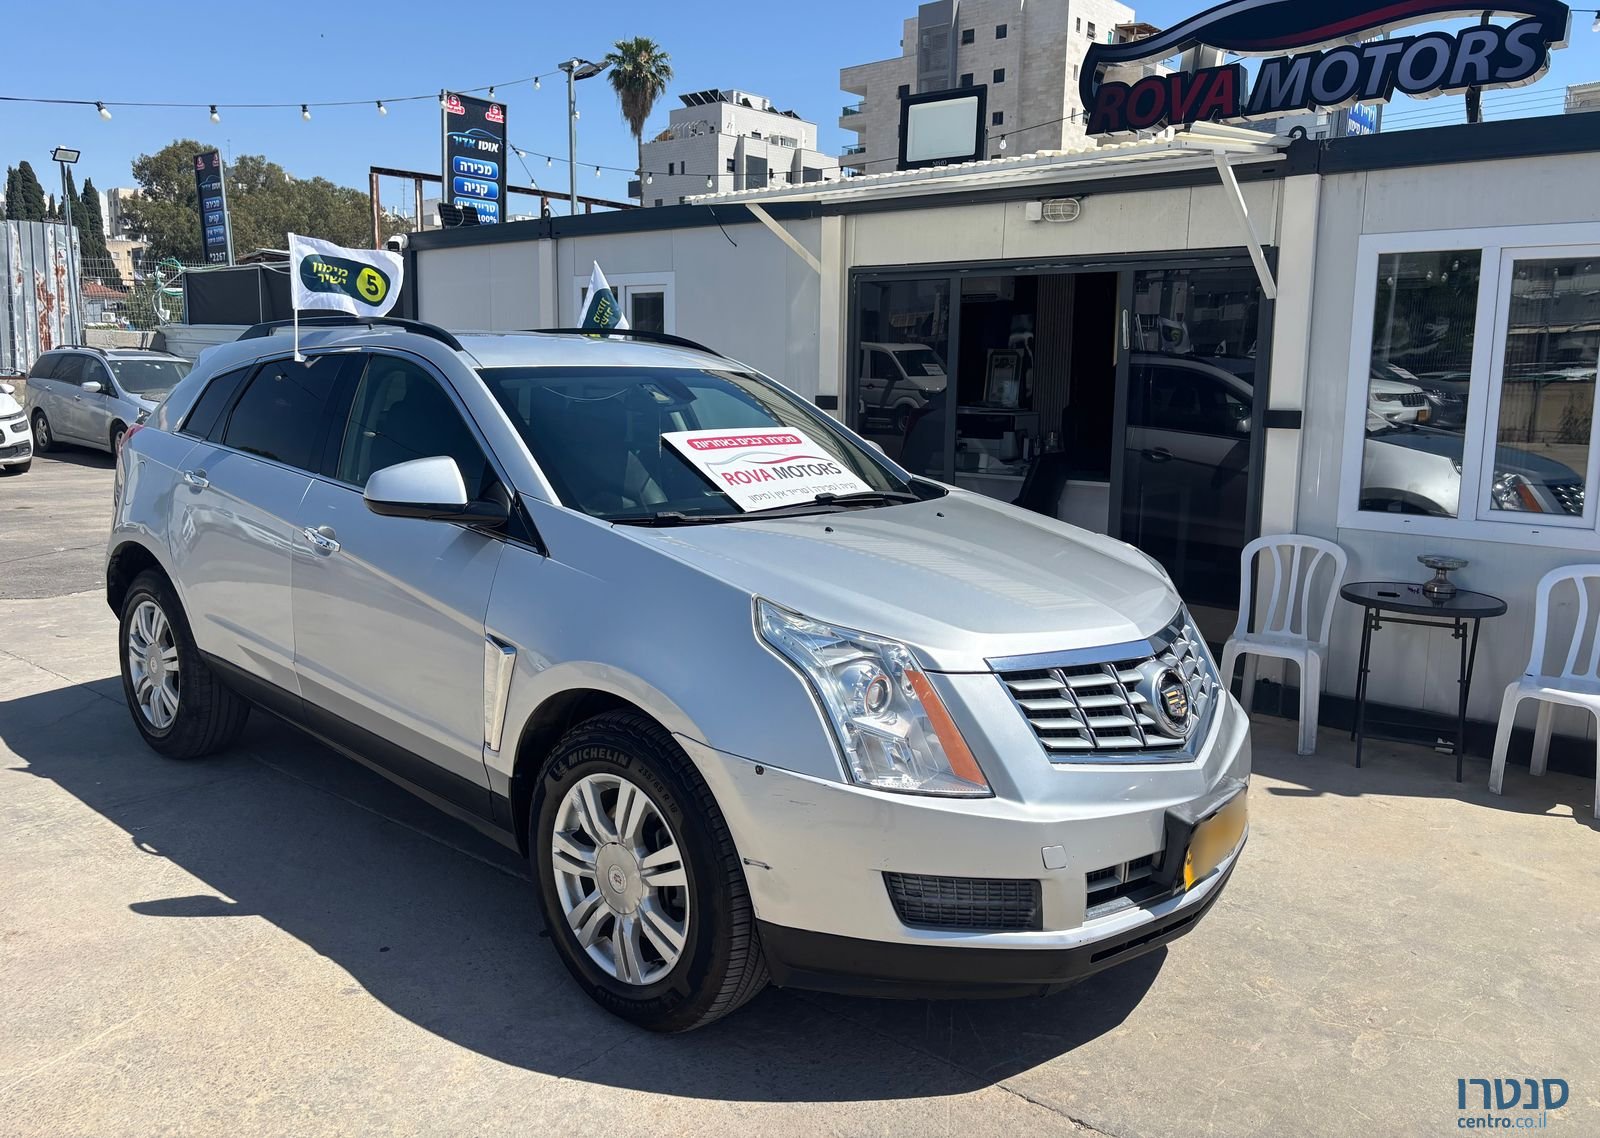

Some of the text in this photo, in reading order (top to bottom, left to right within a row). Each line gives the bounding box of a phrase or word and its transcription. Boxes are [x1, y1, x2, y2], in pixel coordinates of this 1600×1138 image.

[1100, 22, 1544, 128] ROVA MOTORS
[478, 140, 499, 153] אוטו
[460, 161, 492, 175] מכירה
[463, 181, 488, 197] קניה
[312, 261, 349, 277] מימון
[317, 273, 347, 285] ישיר
[365, 274, 379, 296] 5
[593, 296, 611, 323] מימון
[721, 462, 842, 486] ROVA MOTORS
[568, 747, 629, 767] MICHELIN
